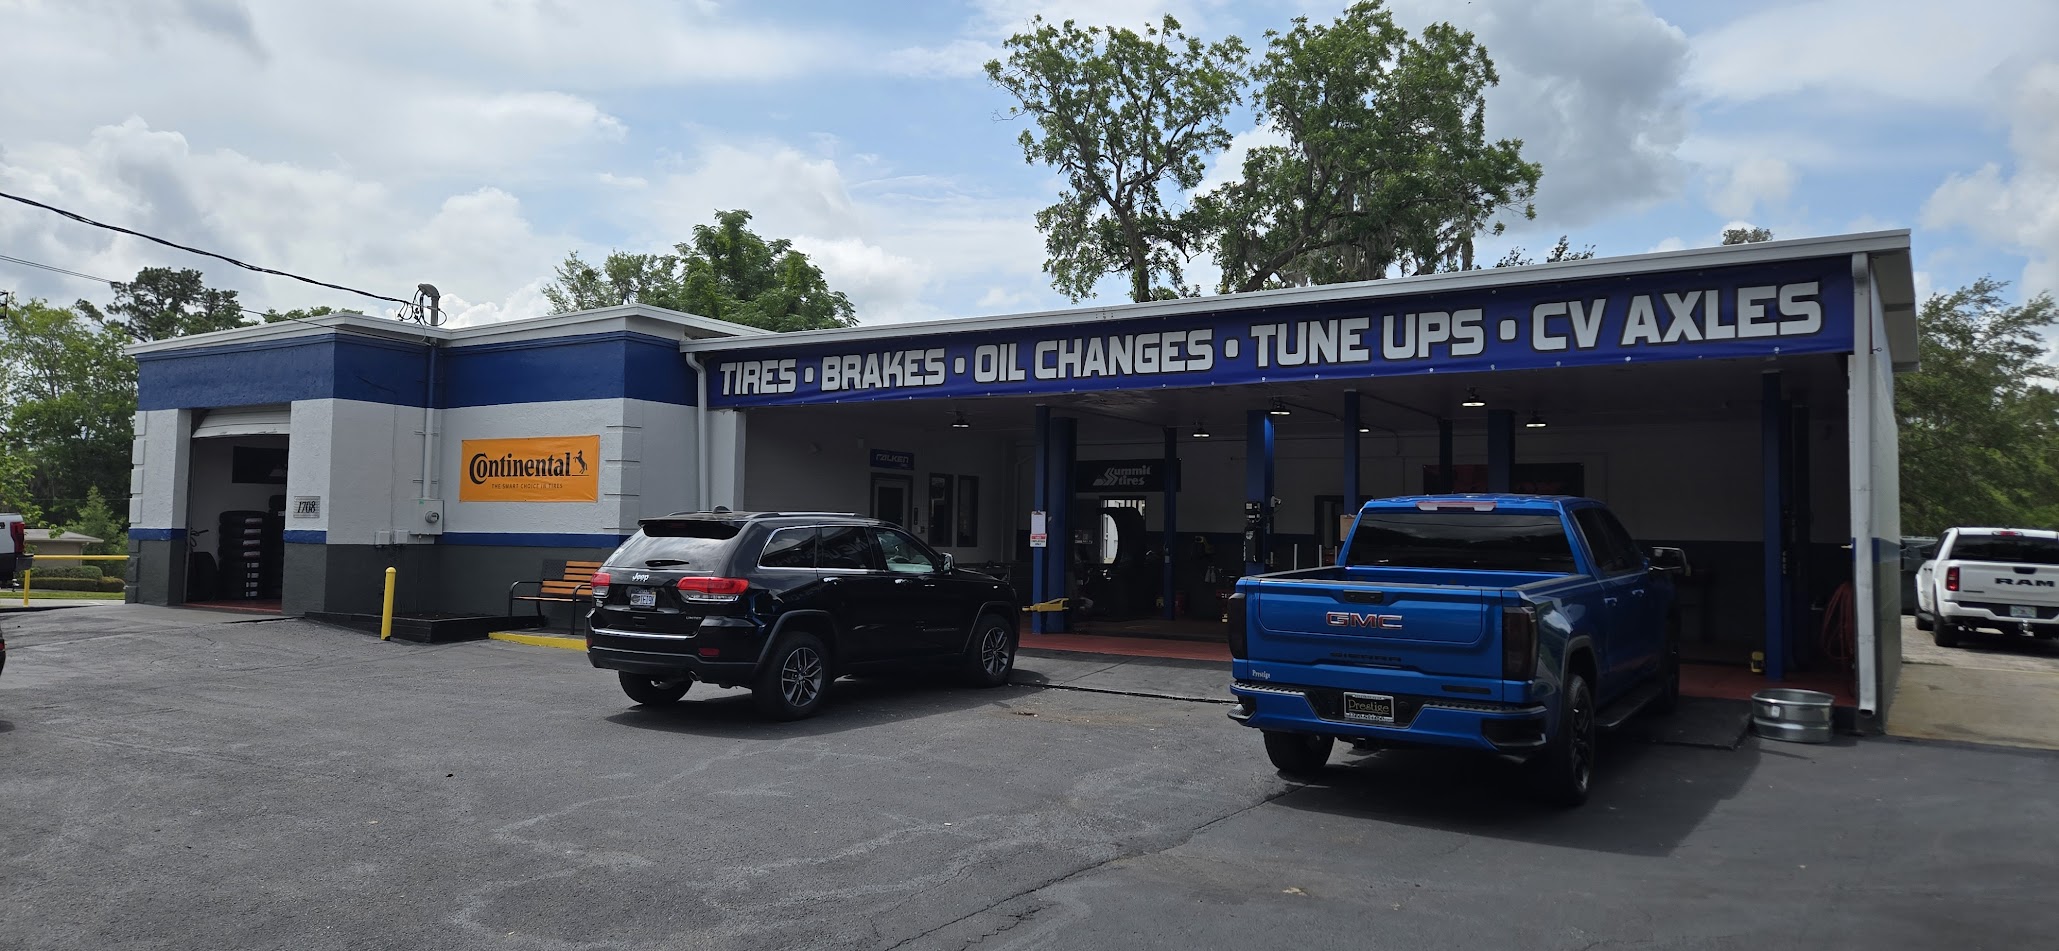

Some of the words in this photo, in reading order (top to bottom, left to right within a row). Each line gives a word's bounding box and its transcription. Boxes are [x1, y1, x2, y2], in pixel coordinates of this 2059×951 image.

[720, 359, 797, 395] TIRES
[821, 348, 945, 391] BRAKES
[974, 342, 1025, 383] OIL
[1034, 329, 1213, 380] CHANGES
[1250, 317, 1370, 367] TUNE
[1383, 308, 1484, 360] UPS
[1532, 298, 1606, 351] CV
[1620, 281, 1822, 346] AXLES
[875, 453, 909, 464] FALKEN
[469, 452, 571, 485] Continental
[1118, 475, 1145, 486] tires
[297, 500, 316, 513] 1708
[631, 572, 650, 583] Jeep
[1994, 578, 2055, 587] RAM
[1325, 611, 1403, 630] GMC
[1347, 699, 1390, 714] Prestige
